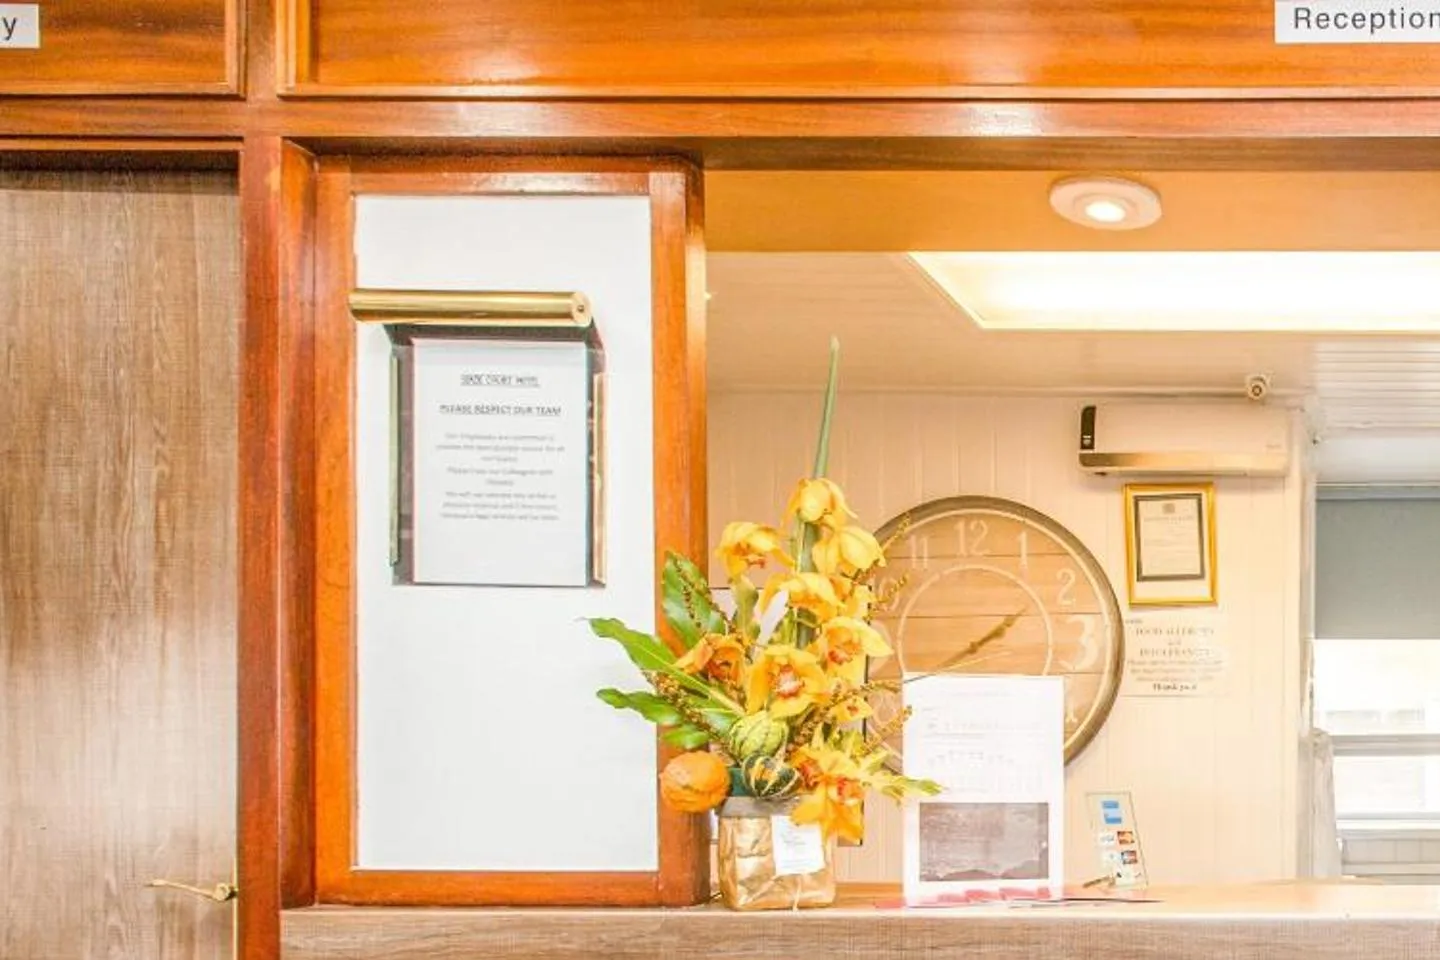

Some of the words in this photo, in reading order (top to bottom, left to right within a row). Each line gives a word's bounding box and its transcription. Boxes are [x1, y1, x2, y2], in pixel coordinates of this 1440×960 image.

[953, 519, 991, 557] 12
[1016, 531, 1029, 568] 1
[1056, 568, 1077, 606] 2
[1059, 615, 1101, 671] 3
